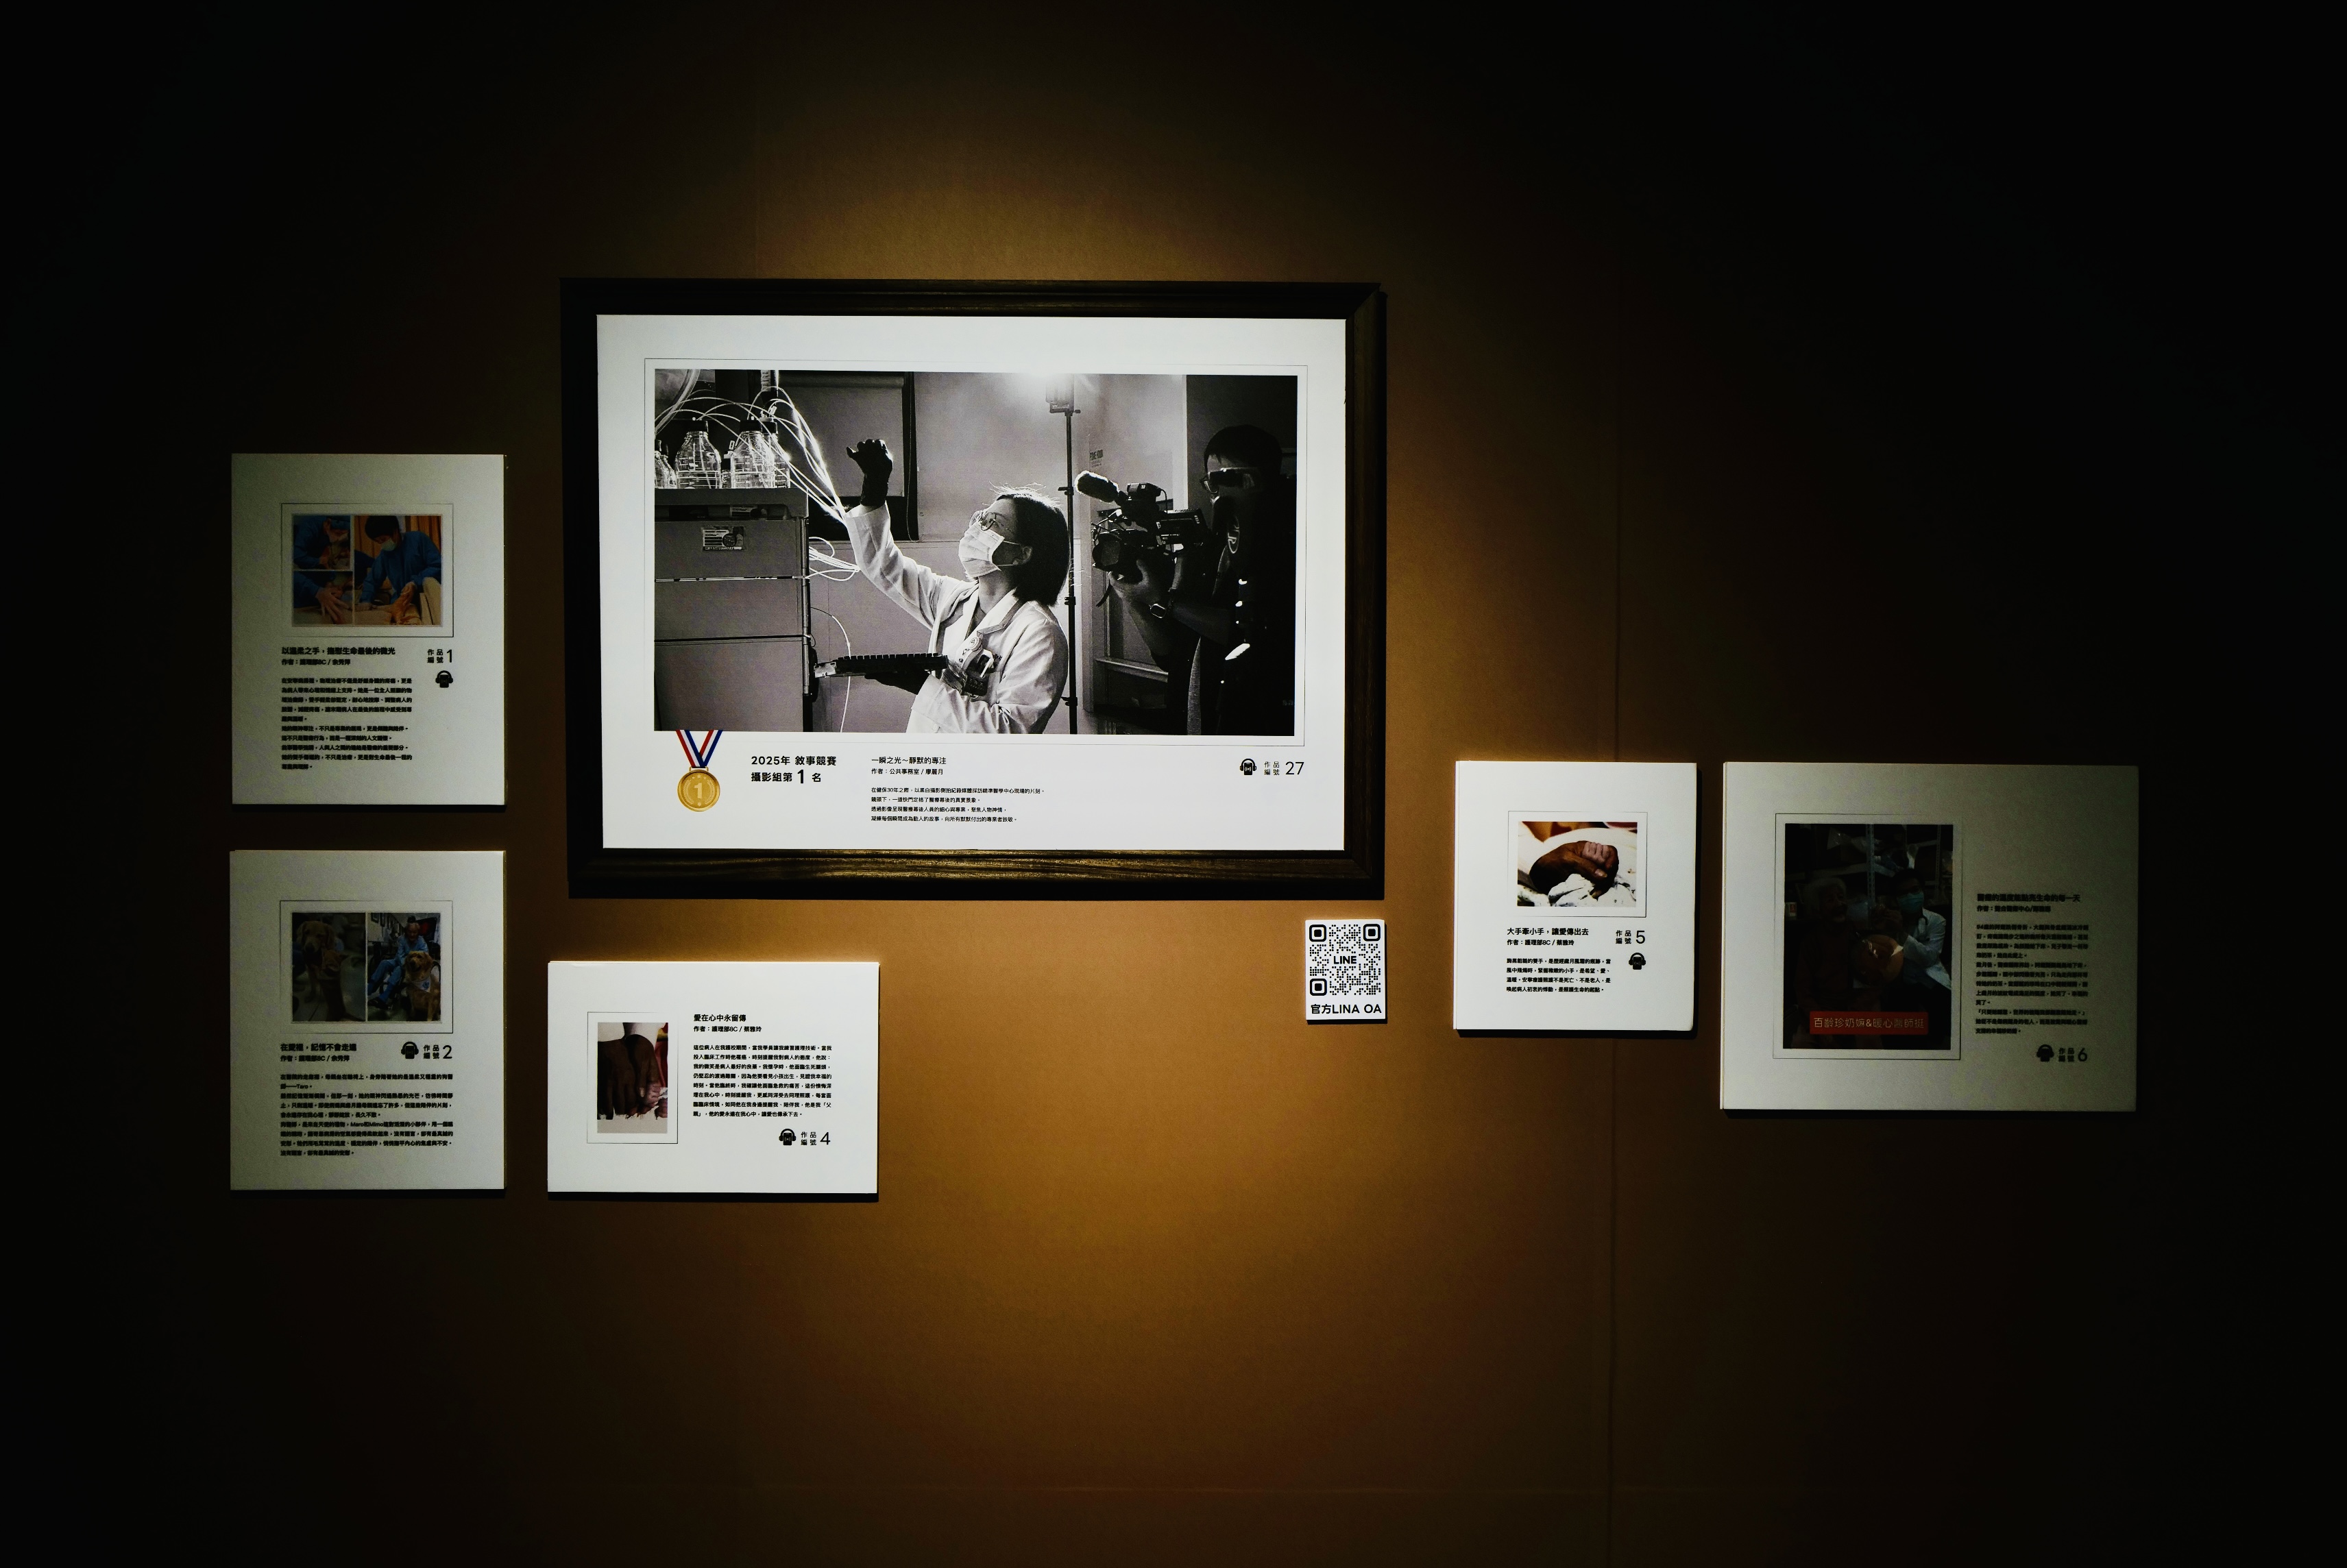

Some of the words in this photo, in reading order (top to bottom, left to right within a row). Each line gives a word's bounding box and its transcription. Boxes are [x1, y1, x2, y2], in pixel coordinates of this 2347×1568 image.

[446, 649, 452, 663] 1
[751, 756, 790, 765] 2025年
[795, 756, 836, 765] 敘事競賽
[1285, 761, 1304, 776] 27
[751, 772, 792, 782] 攝影組第
[797, 770, 804, 783] 1
[812, 773, 821, 782] 名
[694, 783, 703, 799] 1
[1635, 930, 1645, 944] 5
[1333, 956, 1357, 964] LINE
[1311, 1004, 1360, 1014] 官方LINA
[1364, 1004, 1382, 1014] OA
[443, 1045, 452, 1059] 2
[2078, 1048, 2088, 1062] 6
[820, 1131, 831, 1145] 4
